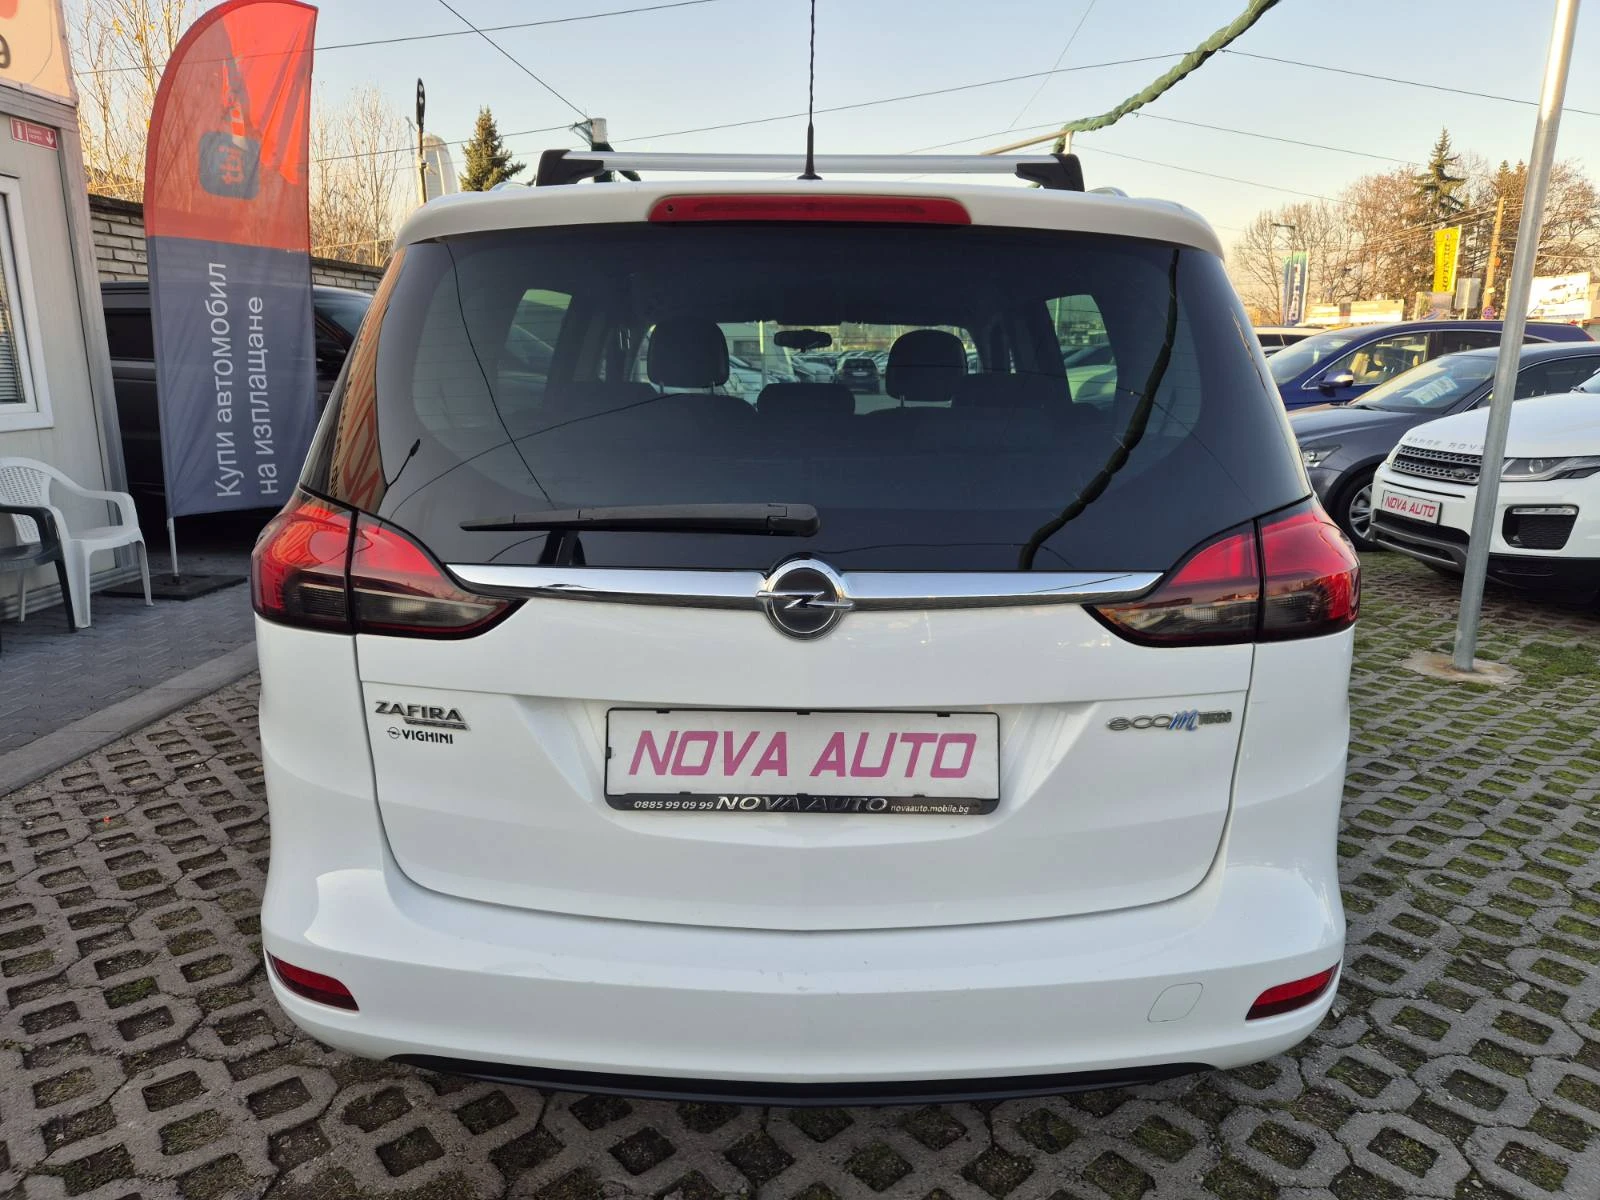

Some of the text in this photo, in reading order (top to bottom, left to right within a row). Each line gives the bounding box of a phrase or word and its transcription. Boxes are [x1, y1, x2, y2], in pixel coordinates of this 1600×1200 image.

[205, 262, 244, 497] Купи автомобил
[248, 296, 279, 494] на изплащане
[1448, 442, 1485, 450] ROV
[1384, 495, 1436, 518] NOVA AUTO
[375, 701, 465, 722] ZAFIRA
[402, 729, 454, 745] VIGHINI
[628, 730, 977, 779] NOVA AUTO
[634, 796, 970, 815] 0885 99 09 99 NOVA AUTO novaauto.mobile.bg
